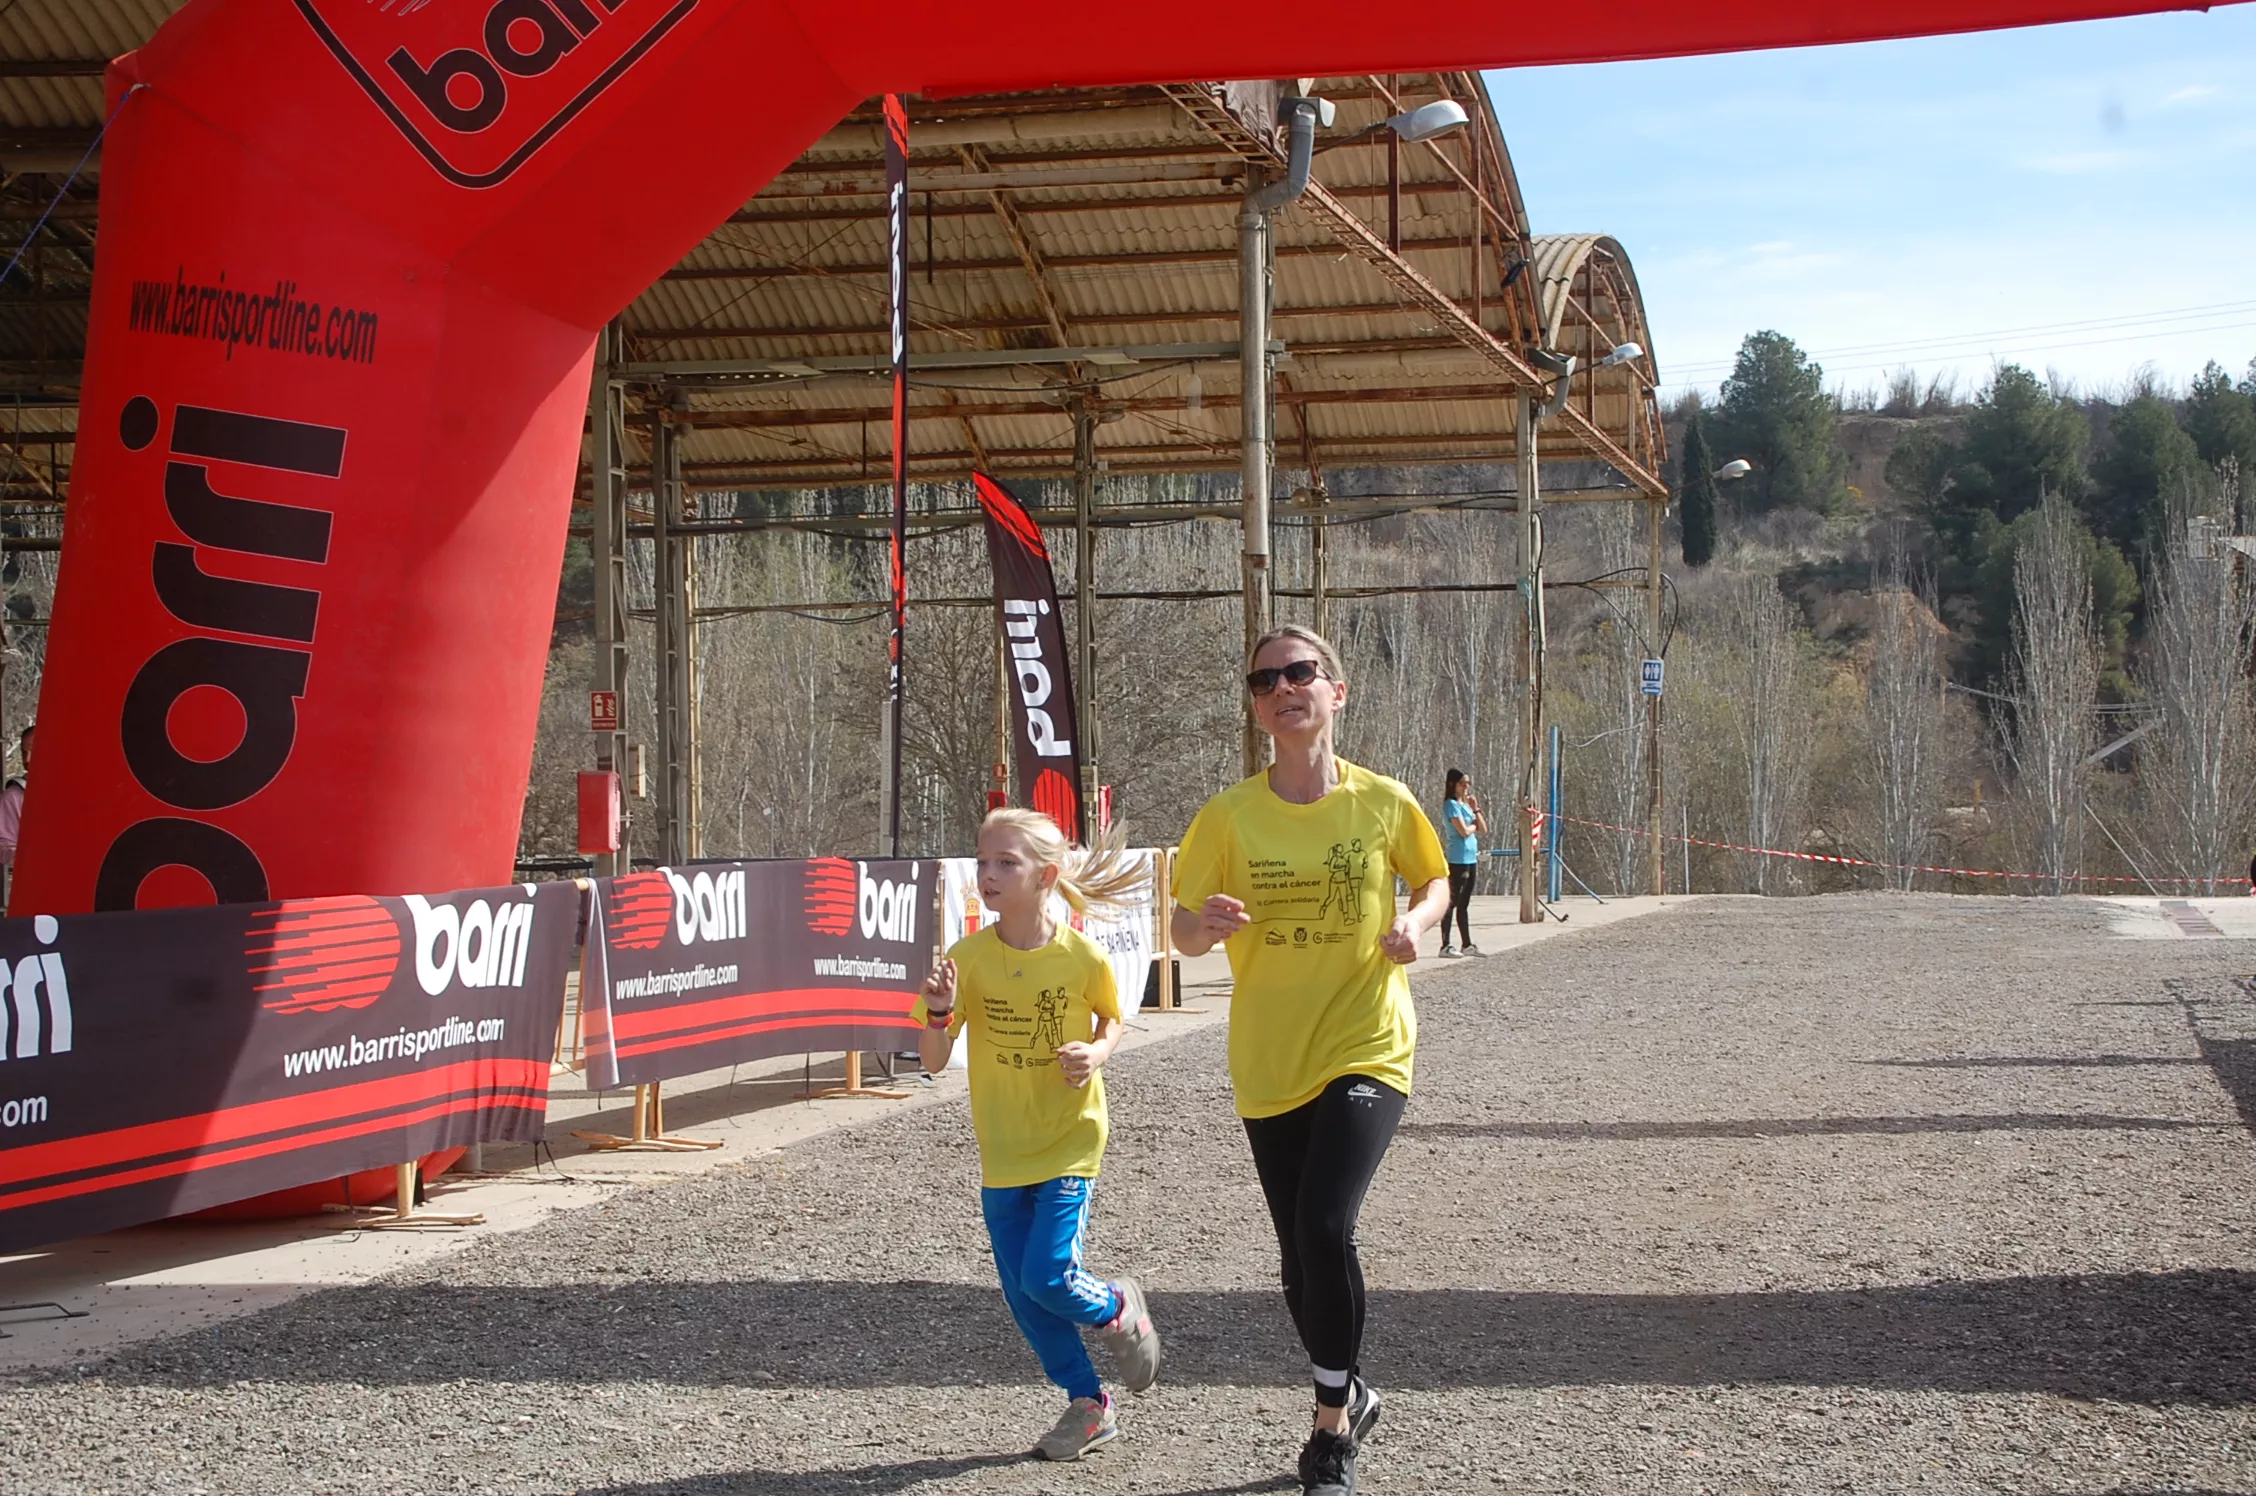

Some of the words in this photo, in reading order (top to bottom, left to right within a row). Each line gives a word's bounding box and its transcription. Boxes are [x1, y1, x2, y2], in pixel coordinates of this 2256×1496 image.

[129, 264, 378, 364] www.barrisportline.com
[1004, 599, 1071, 756] barri
[1248, 859, 1287, 868] Sariñena
[1252, 881, 1277, 890] contra
[1279, 880, 1289, 889] el
[1289, 879, 1321, 888] cáncer
[1261, 869, 1295, 878] marcha
[656, 862, 746, 946] barri
[857, 861, 919, 943] barri
[401, 882, 537, 996] barri
[616, 963, 739, 1000] www.barrisportline.com
[814, 953, 907, 982] www.barrisportline.com
[284, 1016, 505, 1078] www.barrisportline.com
[1354, 1083, 1377, 1095] NIKE
